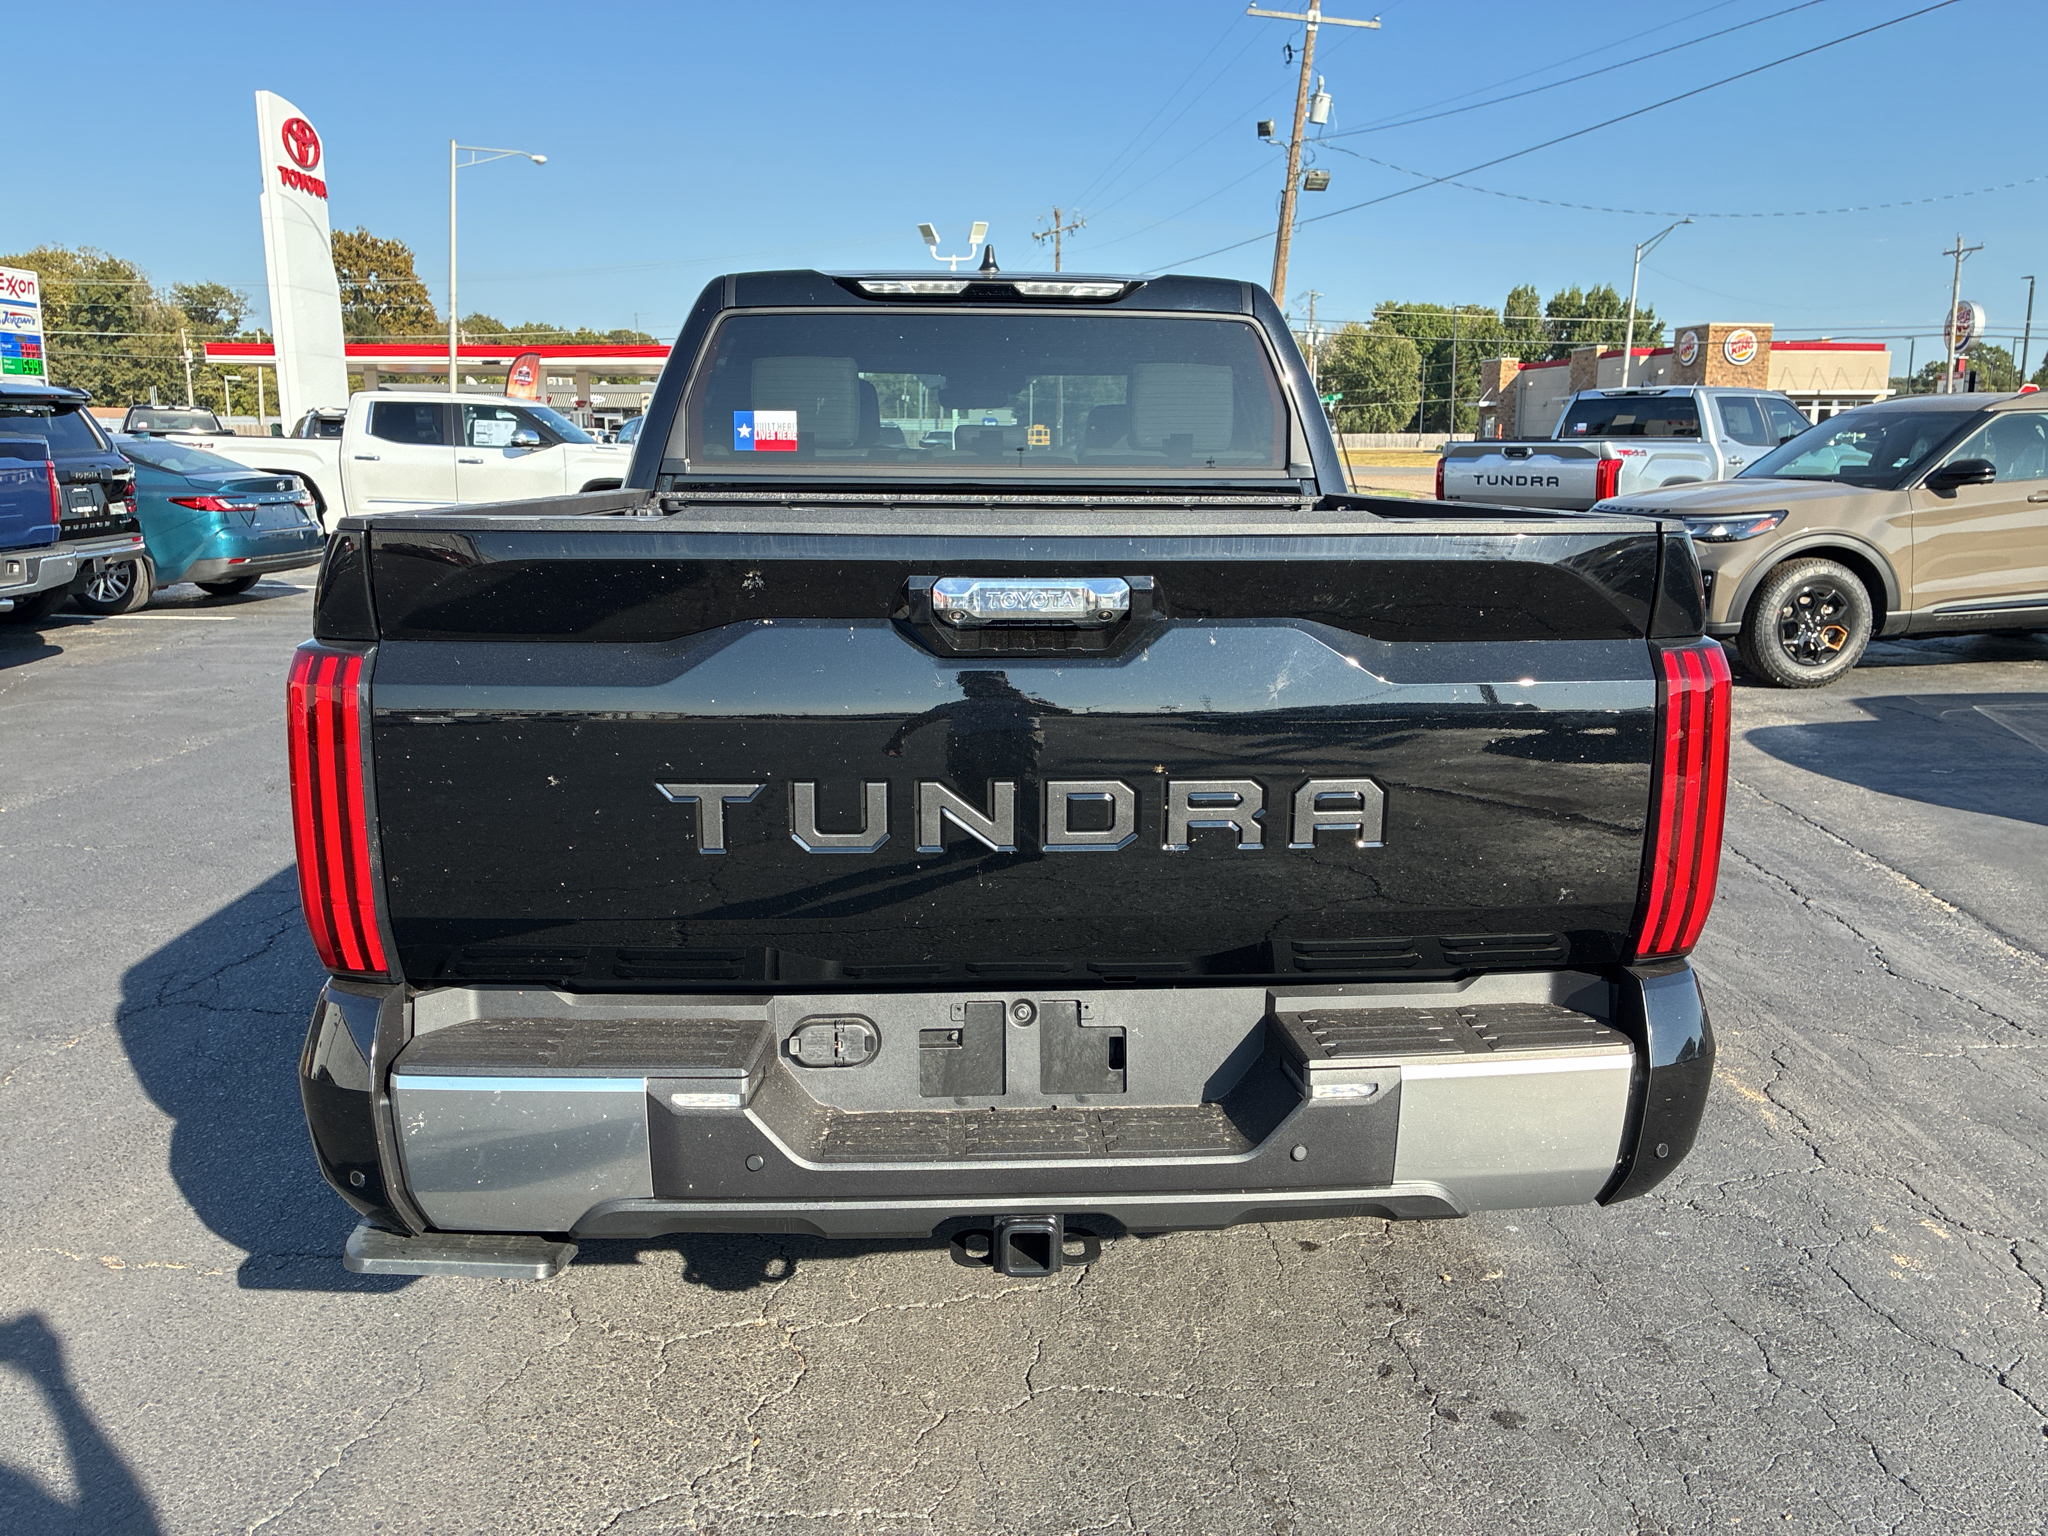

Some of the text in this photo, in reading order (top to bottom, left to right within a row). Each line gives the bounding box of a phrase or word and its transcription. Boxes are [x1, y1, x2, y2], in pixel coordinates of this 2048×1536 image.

[277, 165, 328, 199] TOYOTA
[1731, 335, 1753, 347] BURGER
[1731, 343, 1754, 356] KING
[755, 431, 797, 441] LIVES HERE
[1473, 474, 1559, 488] TUNDRA
[985, 591, 1077, 609] TOYOTA
[654, 778, 1385, 855] TUNDRA
